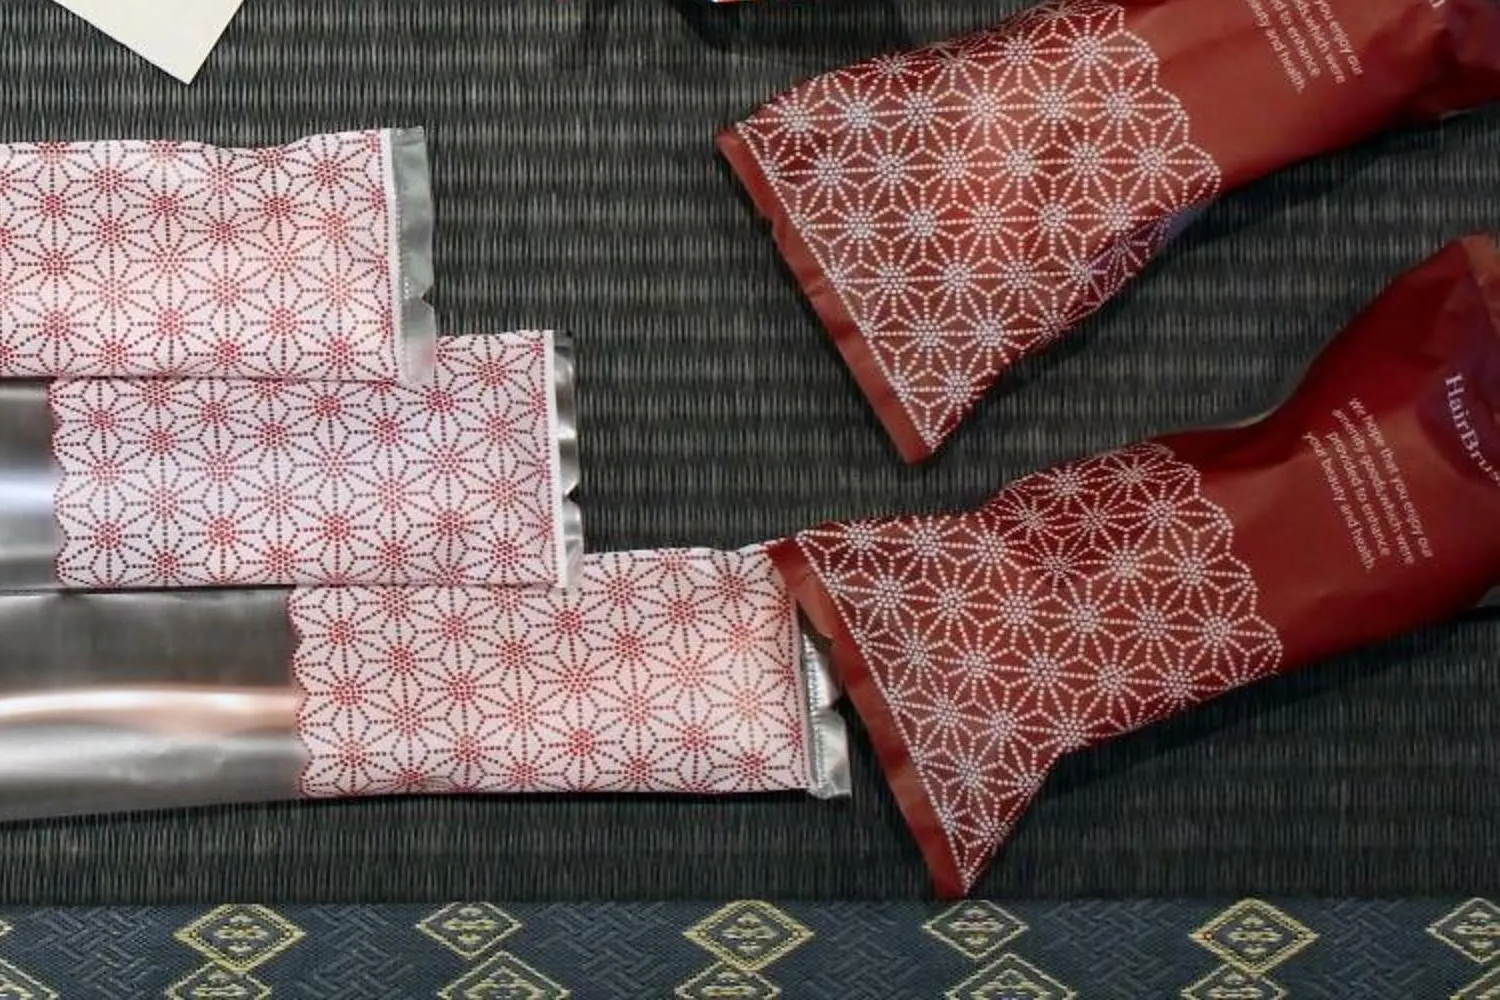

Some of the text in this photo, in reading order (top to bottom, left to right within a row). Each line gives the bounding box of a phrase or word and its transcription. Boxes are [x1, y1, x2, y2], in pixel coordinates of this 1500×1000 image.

[1265, 29, 1287, 52] and
[1279, 10, 1292, 26] to
[1287, 26, 1321, 76] enhance
[1329, 20, 1353, 54] enjoy
[1347, 54, 1363, 75] our
[1324, 52, 1345, 83] were
[1363, 415, 1386, 448] hope
[1380, 447, 1399, 474] that
[1321, 457, 1347, 501] beauty
[1340, 504, 1361, 529] and
[1326, 432, 1390, 556] provided to enhance
[1389, 475, 1409, 500] you
[1403, 501, 1424, 535] enjoy
[1417, 537, 1433, 558] our
